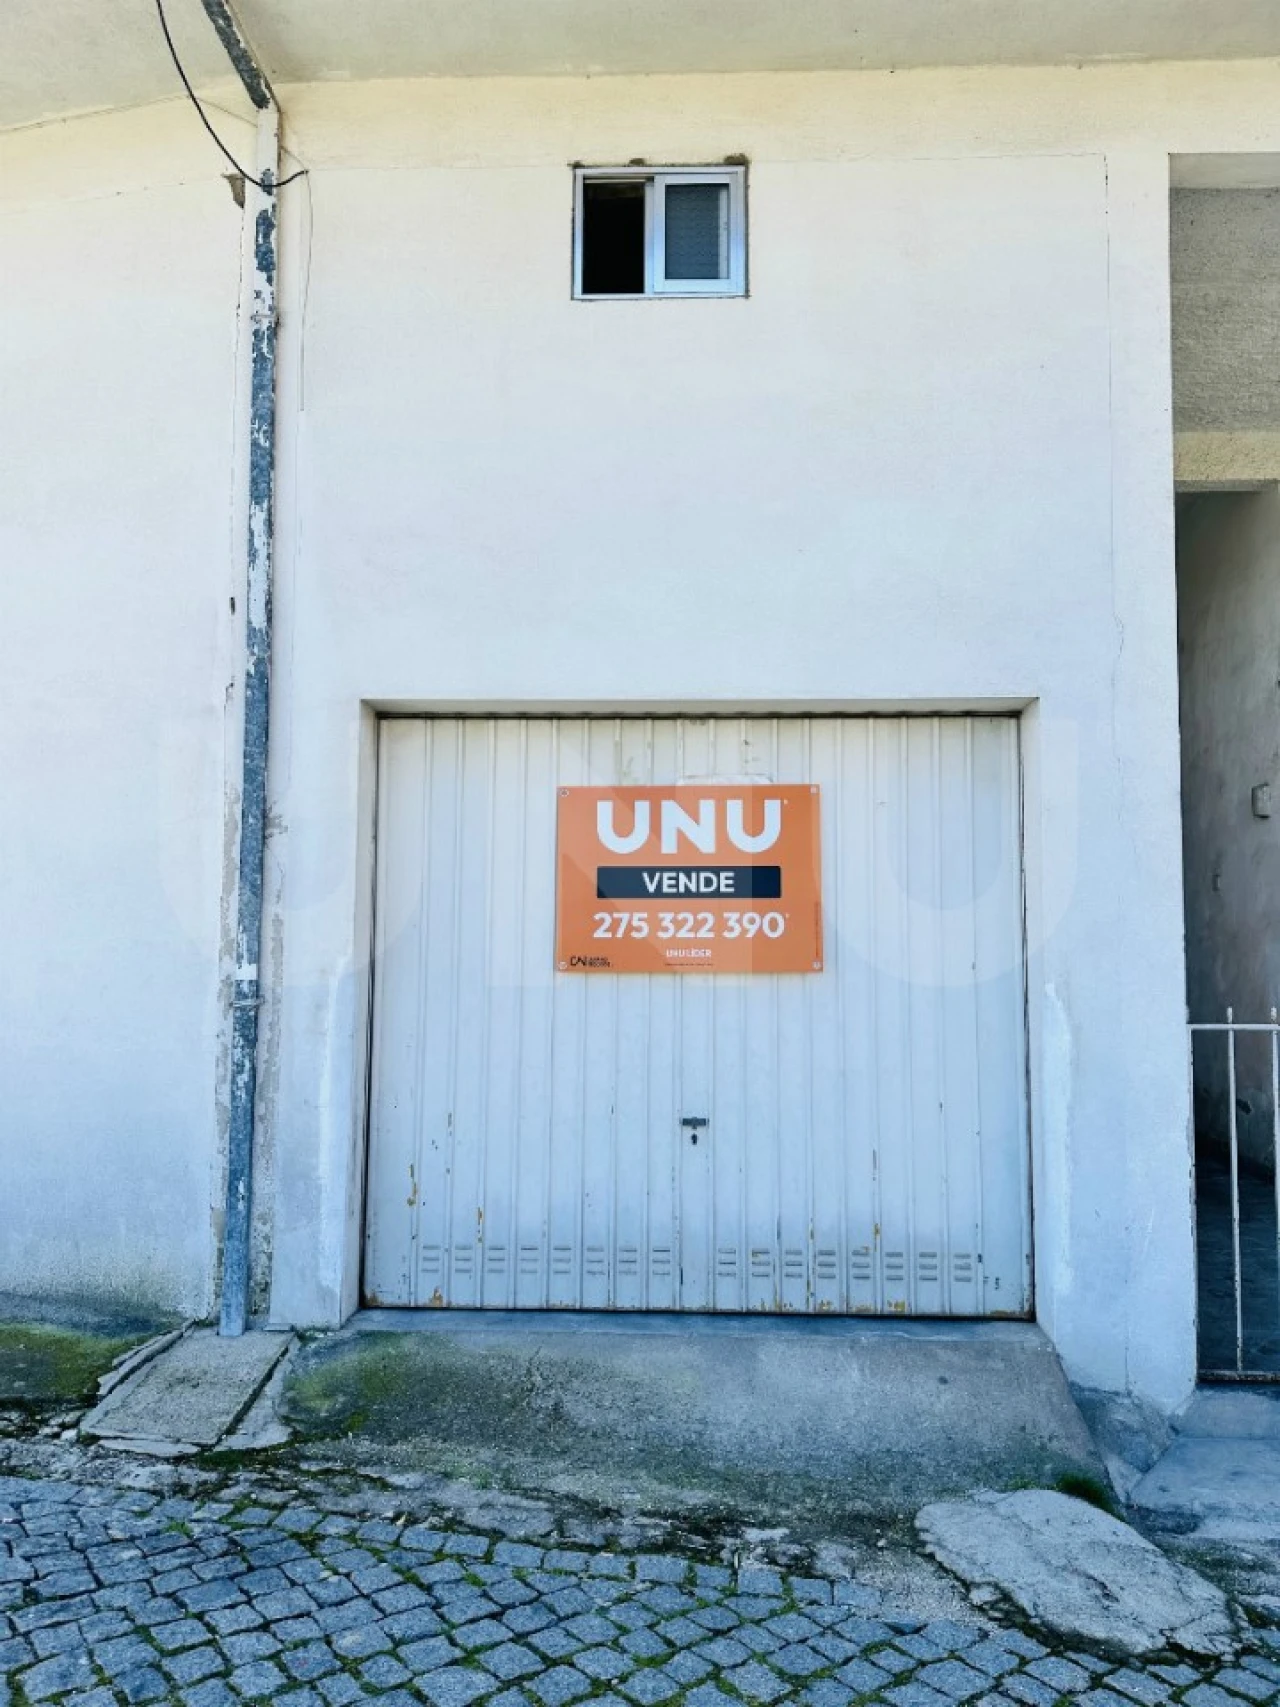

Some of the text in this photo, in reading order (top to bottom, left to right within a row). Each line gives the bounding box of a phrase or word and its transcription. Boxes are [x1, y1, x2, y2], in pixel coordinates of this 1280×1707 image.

[597, 799, 782, 854] UNU
[642, 871, 736, 894] VENDE
[593, 911, 650, 939] 275
[657, 911, 716, 939] 322
[722, 911, 785, 939] 390
